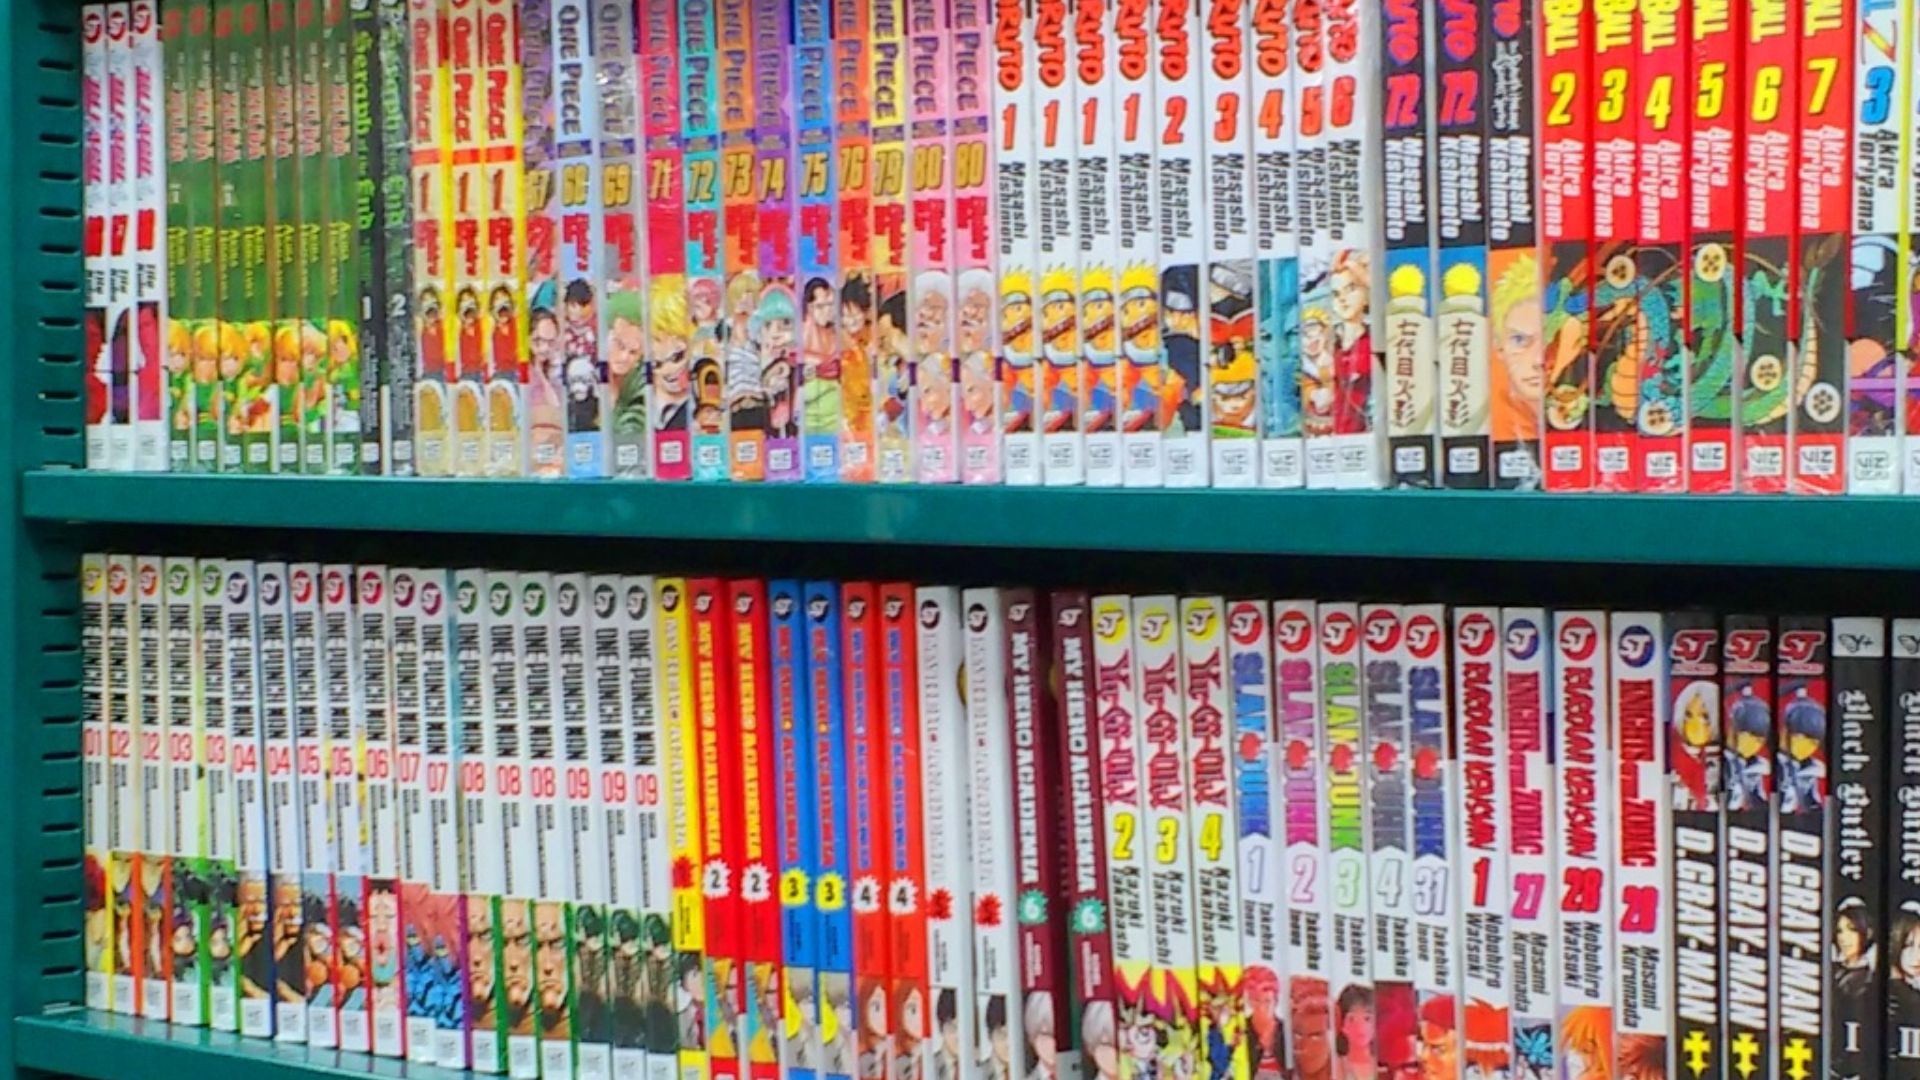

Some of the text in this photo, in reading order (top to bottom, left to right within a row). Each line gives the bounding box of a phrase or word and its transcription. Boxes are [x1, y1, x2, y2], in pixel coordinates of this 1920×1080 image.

[1258, 89, 1284, 138] 4
[1300, 86, 1323, 135] 5
[1330, 75, 1355, 127] 6
[1547, 71, 1577, 126] 2
[1599, 68, 1628, 123] 3
[1645, 76, 1673, 131] 4
[1698, 63, 1727, 118] 5
[1752, 66, 1782, 123] 6
[1808, 58, 1837, 116] 7
[1861, 67, 1895, 125] 3
[1003, 103, 1016, 150] 1
[1044, 100, 1059, 147] 1
[1083, 97, 1098, 144] 1
[1125, 94, 1140, 141] 1
[1162, 96, 1188, 144] 2
[1214, 93, 1239, 142] 3
[687, 159, 716, 204] 72
[725, 152, 754, 198] 73
[756, 156, 786, 202] 74
[801, 152, 830, 198] 75
[839, 144, 869, 192] 76
[874, 150, 905, 197] 79
[914, 144, 945, 191] 80
[956, 141, 987, 189] 80
[1341, 139, 1363, 223] Masashi
[1402, 136, 1426, 225] Masashi
[1458, 134, 1483, 222] Masashi
[1561, 138, 1584, 196] Akira
[1613, 138, 1636, 197] Akira
[1659, 139, 1682, 199] Akira
[1689, 128, 1711, 228] Toriyama
[1709, 126, 1733, 187] Akira
[1745, 132, 1766, 233] Toriyama
[1765, 130, 1788, 191] Akira
[1800, 127, 1822, 230] Toriyama
[1821, 125, 1847, 186] Akira
[1858, 131, 1877, 232] Toriyama
[1876, 129, 1899, 189] Akira
[460, 173, 469, 212] 1
[494, 170, 504, 210] 1
[562, 163, 589, 206] 68
[604, 163, 632, 207] 69
[1000, 163, 1012, 254] Kishimoto
[1011, 162, 1028, 239] Masashi
[1119, 154, 1134, 248] Kishimoto
[1132, 153, 1151, 232] Masashi
[1160, 159, 1174, 254] Kishimoto
[1173, 157, 1192, 238] Masashi
[1212, 154, 1227, 249] Kishimoto
[1227, 153, 1247, 234] Masashi
[1257, 153, 1272, 250] Kishimoto
[1272, 151, 1293, 233] Masashi
[1328, 141, 1343, 241] Kishimoto
[1385, 139, 1406, 240] Kishimoto
[1440, 138, 1460, 238] Kishimoto
[1543, 139, 1563, 238] Toriyama
[1593, 139, 1614, 238] Toriyama
[1639, 141, 1660, 241] Toriyama
[363, 296, 371, 319] 1
[388, 294, 405, 316] 2
[84, 728, 101, 756] 01
[109, 729, 129, 758] 02
[141, 732, 160, 760] 02
[172, 733, 192, 761] 03
[205, 735, 225, 763] 03
[233, 744, 256, 773] 04
[267, 747, 289, 776] 04
[298, 745, 320, 773] 05
[331, 747, 352, 776] 05
[367, 749, 389, 778] 06
[400, 753, 420, 782] 07
[427, 762, 448, 792] 07
[461, 762, 486, 792] 08
[497, 765, 521, 796] 08
[531, 767, 555, 797] 08
[567, 768, 590, 799] 09
[602, 771, 627, 802] 09
[636, 774, 658, 805] 09
[1837, 690, 1874, 880] Black Butler
[1017, 747, 1039, 883] ACADEMIA
[1112, 812, 1136, 860] 2
[1156, 817, 1179, 864] 3
[1200, 813, 1224, 862] 4
[710, 870, 723, 889] 2
[751, 874, 763, 893] 2
[788, 878, 800, 897] 3
[824, 882, 836, 902] 3
[860, 885, 873, 903] 4
[896, 888, 909, 905] 4
[1126, 866, 1143, 929] Kazuki
[1250, 846, 1265, 894] 1
[1291, 854, 1316, 904] 2
[1334, 858, 1360, 908] 3
[1376, 858, 1402, 907] 4
[1412, 867, 1449, 916] 31
[1473, 857, 1491, 907] 1
[1511, 872, 1547, 920] 27
[1561, 867, 1604, 913] 28
[1113, 866, 1130, 959] Takahashi
[1153, 871, 1172, 965] Takahashi
[1169, 870, 1187, 934] Kazuki
[1200, 867, 1218, 962] Takahashi
[1217, 867, 1233, 931] Kazuki
[1620, 885, 1659, 935] 28
[1676, 826, 1716, 1024] D.GRAY-MAN
[1259, 902, 1275, 961] Takehiko
[1305, 911, 1320, 971] Takehiko
[1349, 916, 1365, 976] Takehiko
[1393, 916, 1409, 977] Takehiko
[1465, 913, 1483, 979] Watsuki
[1484, 912, 1503, 990] Nobuhiro
[1727, 825, 1767, 1029] D.GRAY-MAN
[1780, 829, 1821, 1035] D.GRAY-MAN
[1433, 925, 1452, 986] Takehiko
[1513, 931, 1531, 1014] Kurumada
[1530, 932, 1550, 996] Masami
[1562, 921, 1583, 989] Watsuki
[1584, 921, 1601, 998] Nobuhiro
[1640, 945, 1660, 1011] Masami
[1621, 944, 1640, 1028] Kurumada
[1844, 1021, 1860, 1052] I
